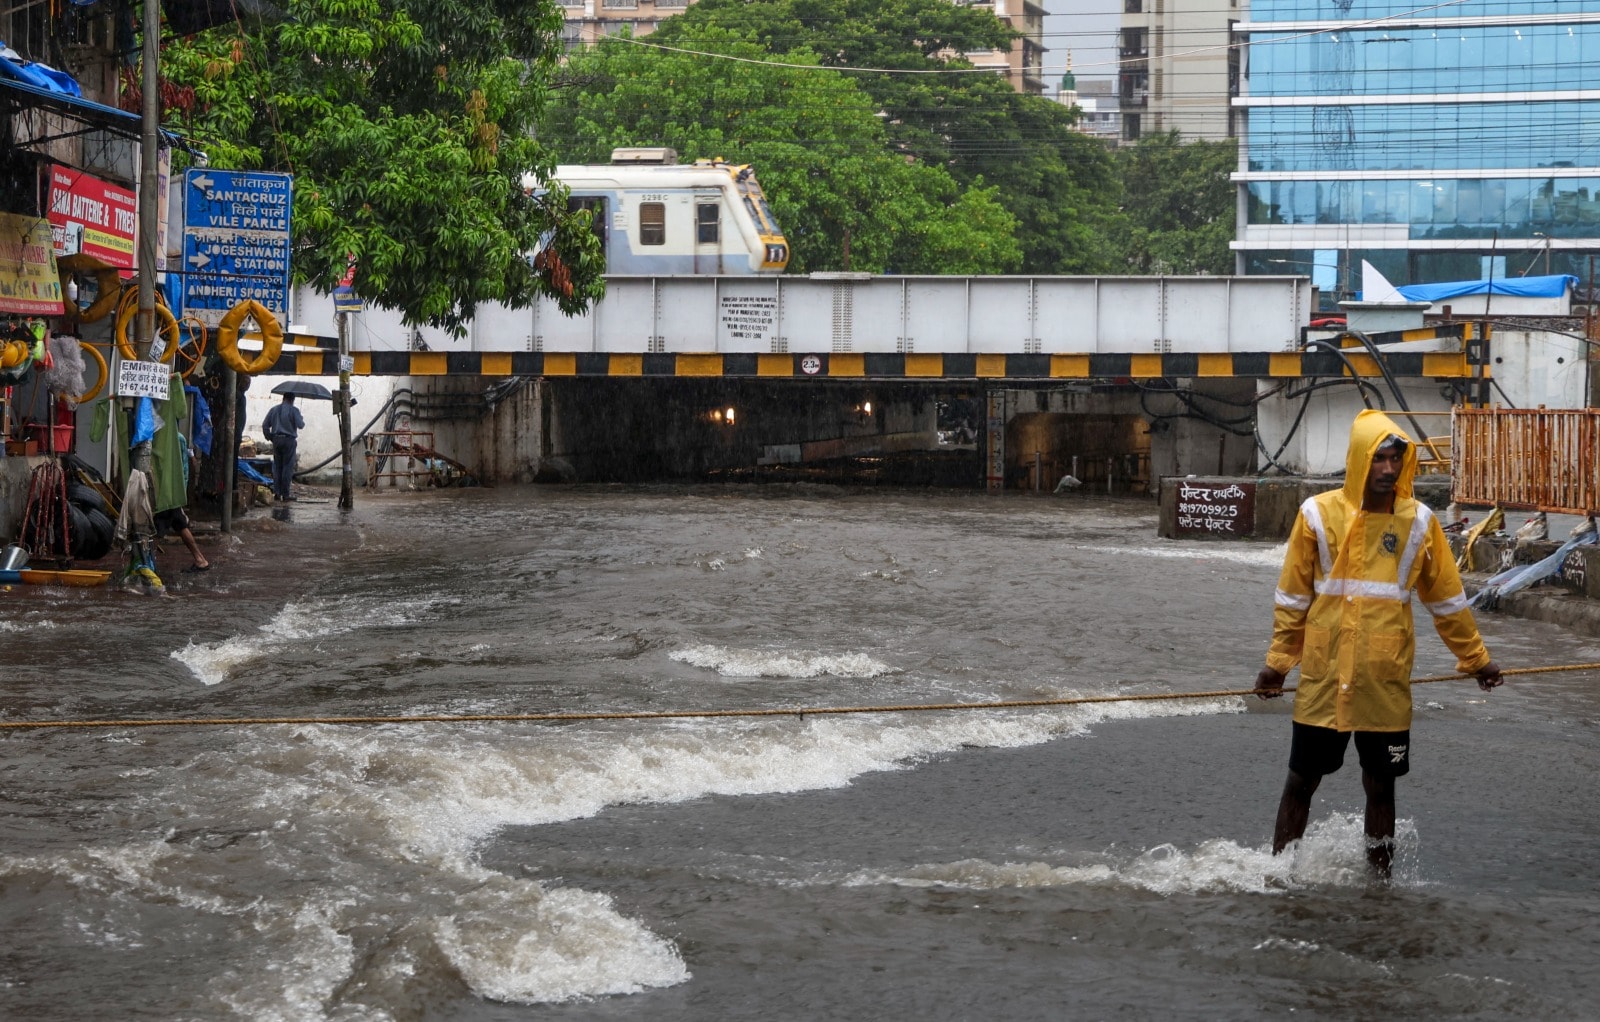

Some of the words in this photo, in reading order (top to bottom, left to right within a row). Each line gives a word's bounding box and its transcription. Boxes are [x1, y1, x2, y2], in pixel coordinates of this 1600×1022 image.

[231, 176, 286, 192] सांताक्रुज
[206, 190, 286, 204] SANTACRUZ
[72, 194, 103, 225] BATTERIE
[104, 204, 110, 227] &
[115, 208, 134, 234] TYRES
[232, 203, 257, 216] विले
[261, 205, 285, 218] पार्ले
[210, 216, 239, 227] VILE
[244, 218, 285, 229] PARLE
[205, 245, 285, 258] JOGESHWARI
[235, 258, 284, 270] STATION
[188, 286, 236, 297] ANDHERI
[240, 288, 283, 299] SPORTS
[226, 298, 282, 312] COEX
[1180, 482, 1212, 501] पेन्टर
[1179, 503, 1238, 517] 9819709925
[1204, 516, 1234, 532] पेन्टर
